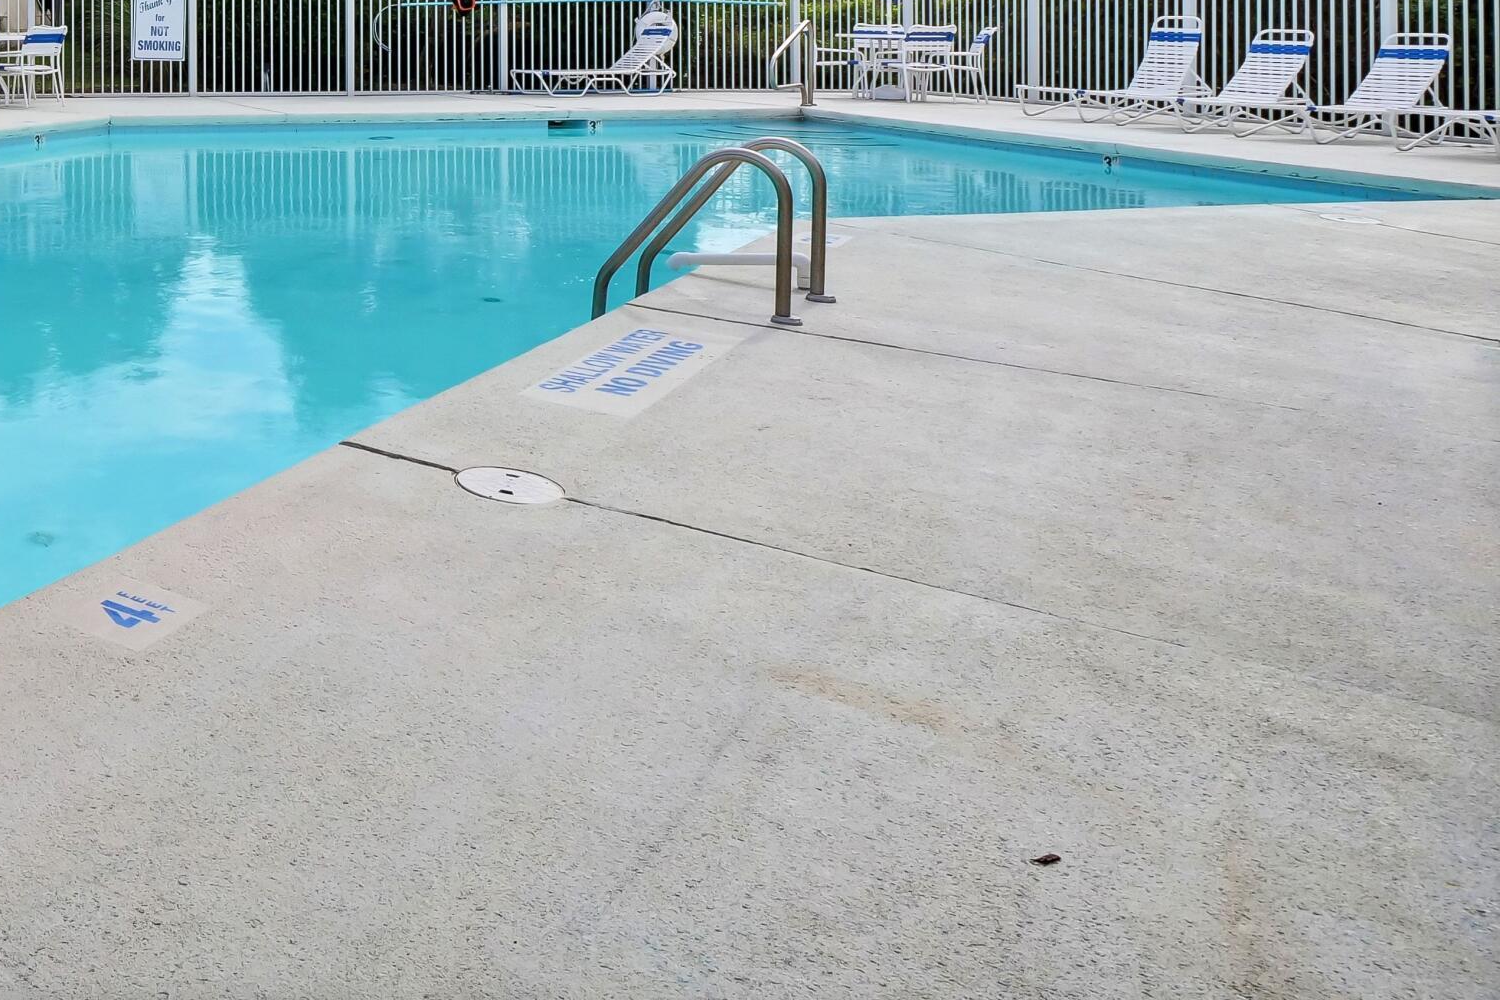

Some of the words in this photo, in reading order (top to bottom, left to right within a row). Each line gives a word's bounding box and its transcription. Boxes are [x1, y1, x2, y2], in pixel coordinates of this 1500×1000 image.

[155, 13, 165, 22] for
[150, 25, 170, 36] NOT
[137, 40, 181, 52] SMOKING
[538, 351, 627, 393] SHALLOW
[607, 329, 670, 355] WATER
[595, 376, 649, 397] NO
[625, 340, 704, 377] DIVING
[116, 590, 177, 613] FEET
[100, 599, 161, 629] 4
